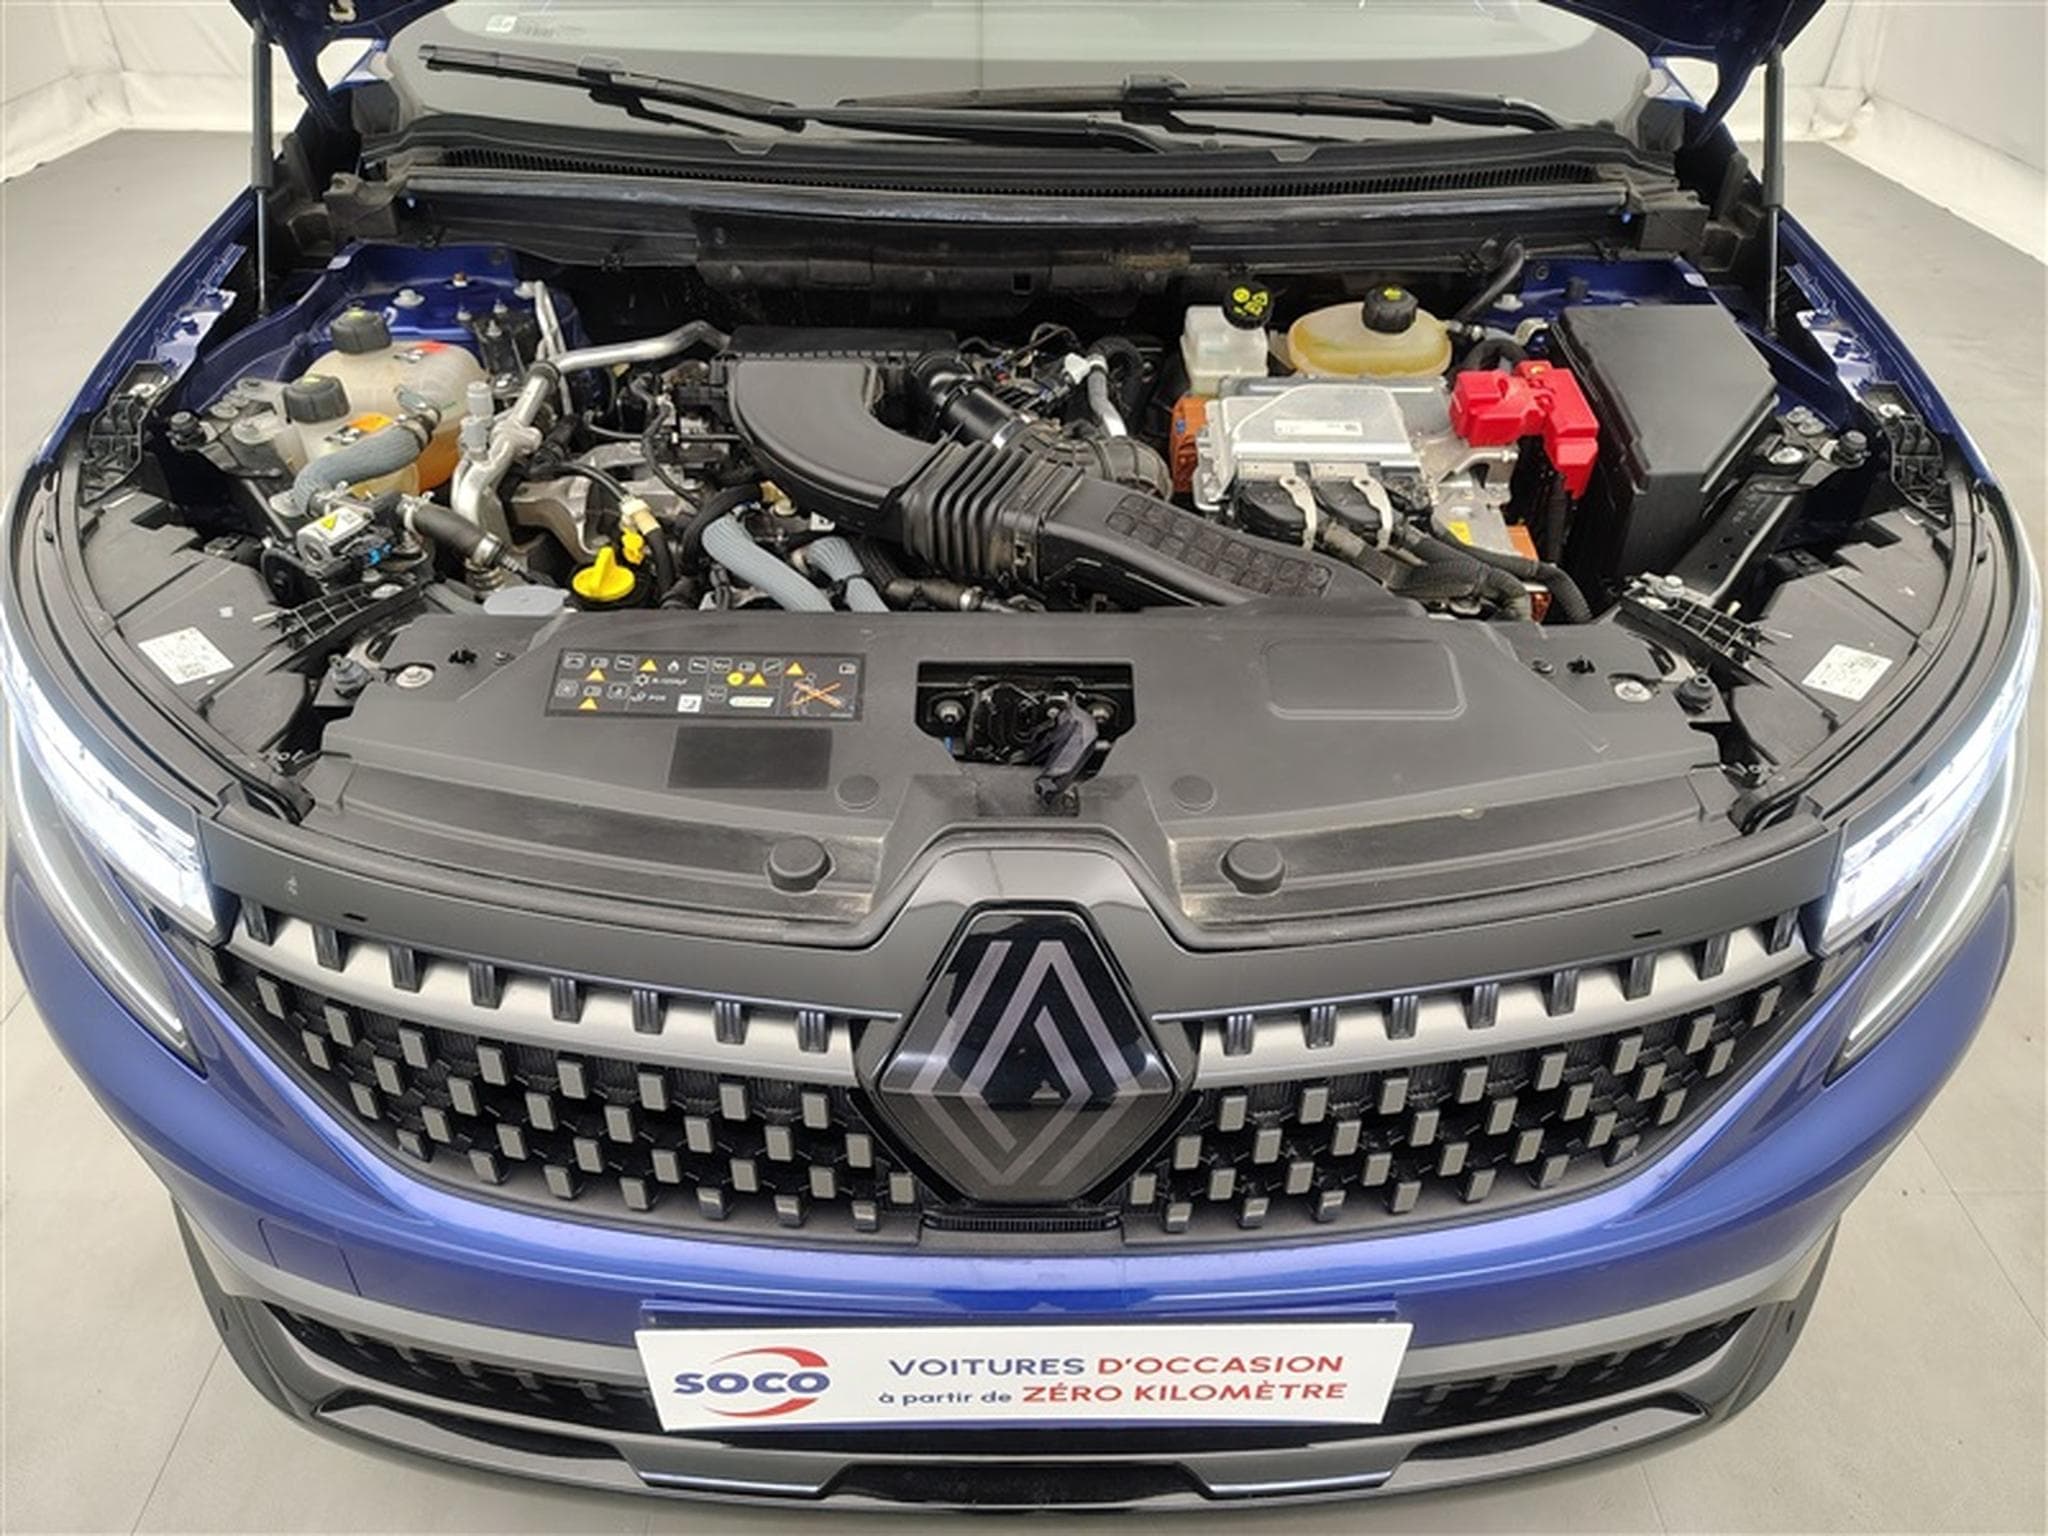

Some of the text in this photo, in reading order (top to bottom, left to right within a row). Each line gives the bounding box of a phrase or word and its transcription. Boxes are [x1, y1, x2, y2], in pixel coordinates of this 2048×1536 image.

[889, 1355, 1344, 1375] VOITURES D'OCCASION
[673, 1372, 831, 1394] SOCO
[878, 1380, 1348, 1406] à partir de ZÉRO KILOMÈTRE
